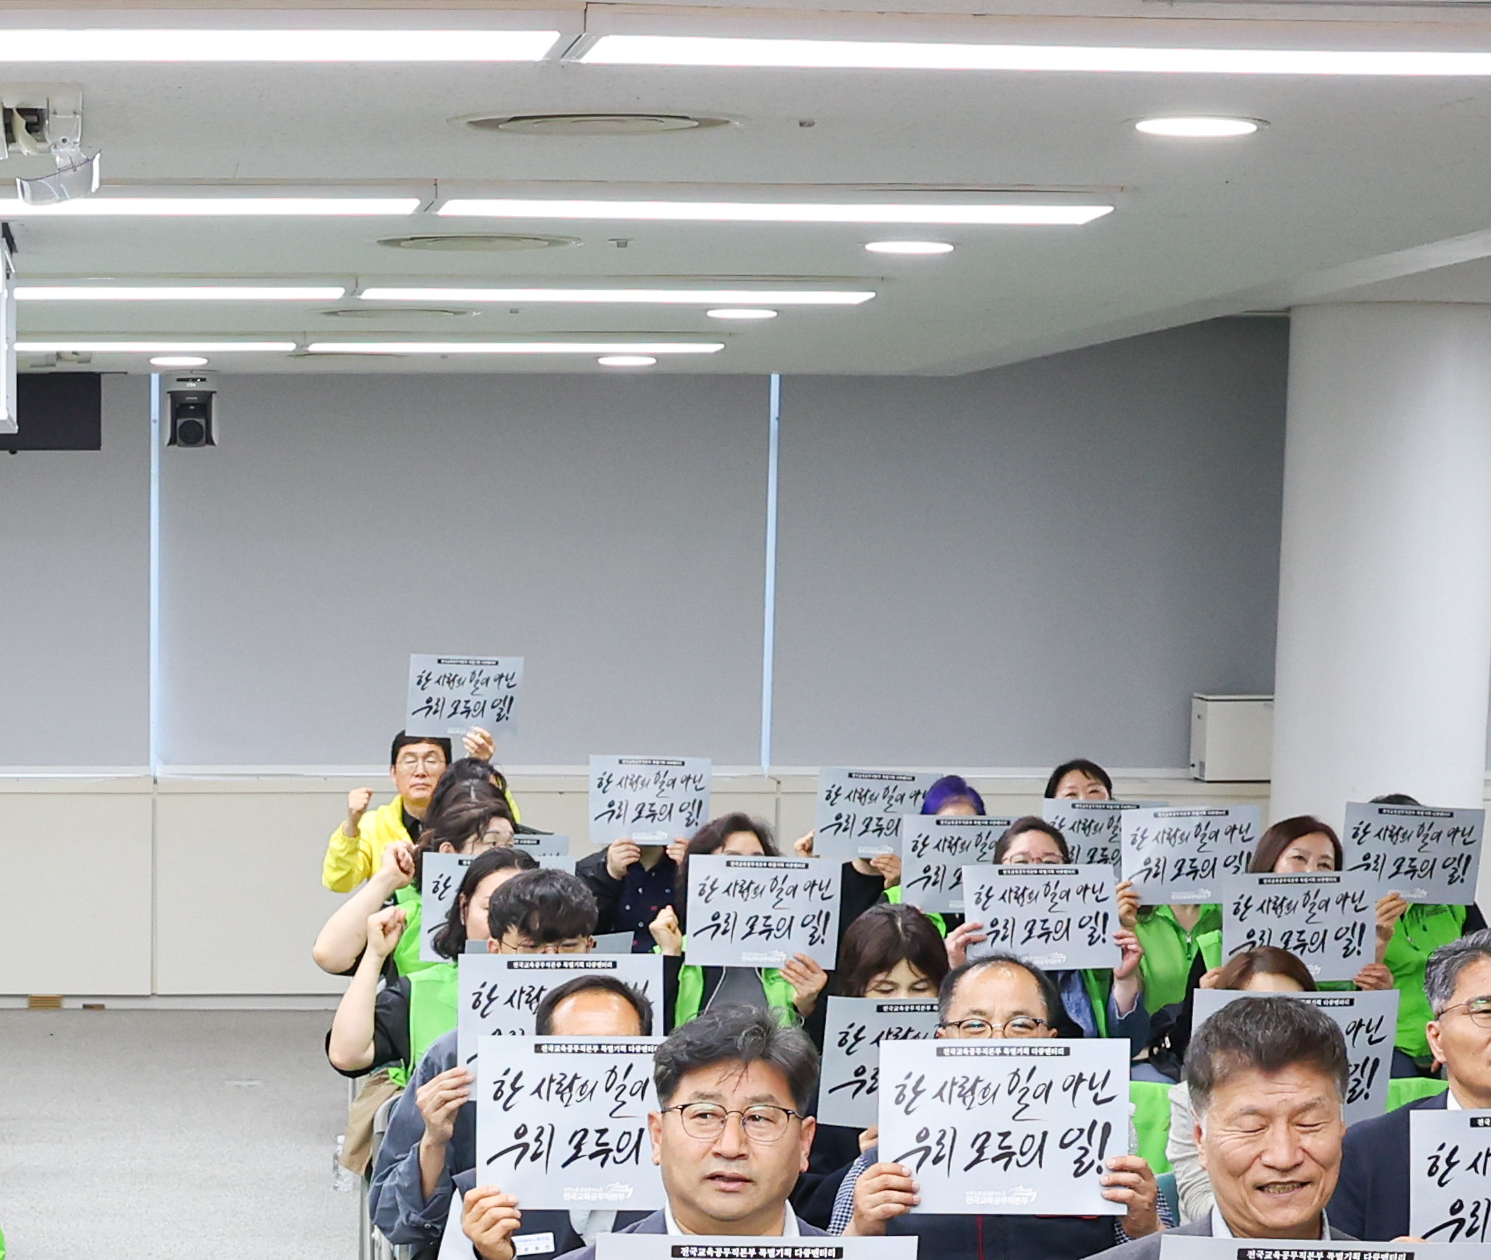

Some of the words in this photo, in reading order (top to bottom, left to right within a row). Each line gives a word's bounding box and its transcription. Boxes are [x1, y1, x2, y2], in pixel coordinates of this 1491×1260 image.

[698, 875, 719, 903] 한
[721, 879, 765, 901] 사람의
[770, 874, 797, 909] 일이
[803, 878, 835, 902] 아닌
[693, 911, 737, 943] 우리
[741, 915, 794, 940] 모두의
[800, 909, 831, 946] 일!
[894, 1071, 926, 1115] 한
[931, 1075, 1001, 1110] 사람의
[1007, 1064, 1053, 1121] 일이
[1062, 1068, 1117, 1108] 아닌
[891, 1126, 957, 1179] 우리
[963, 1131, 1048, 1172] 모두의
[1059, 1118, 1110, 1178] 일!
[1427, 1142, 1460, 1187] 한
